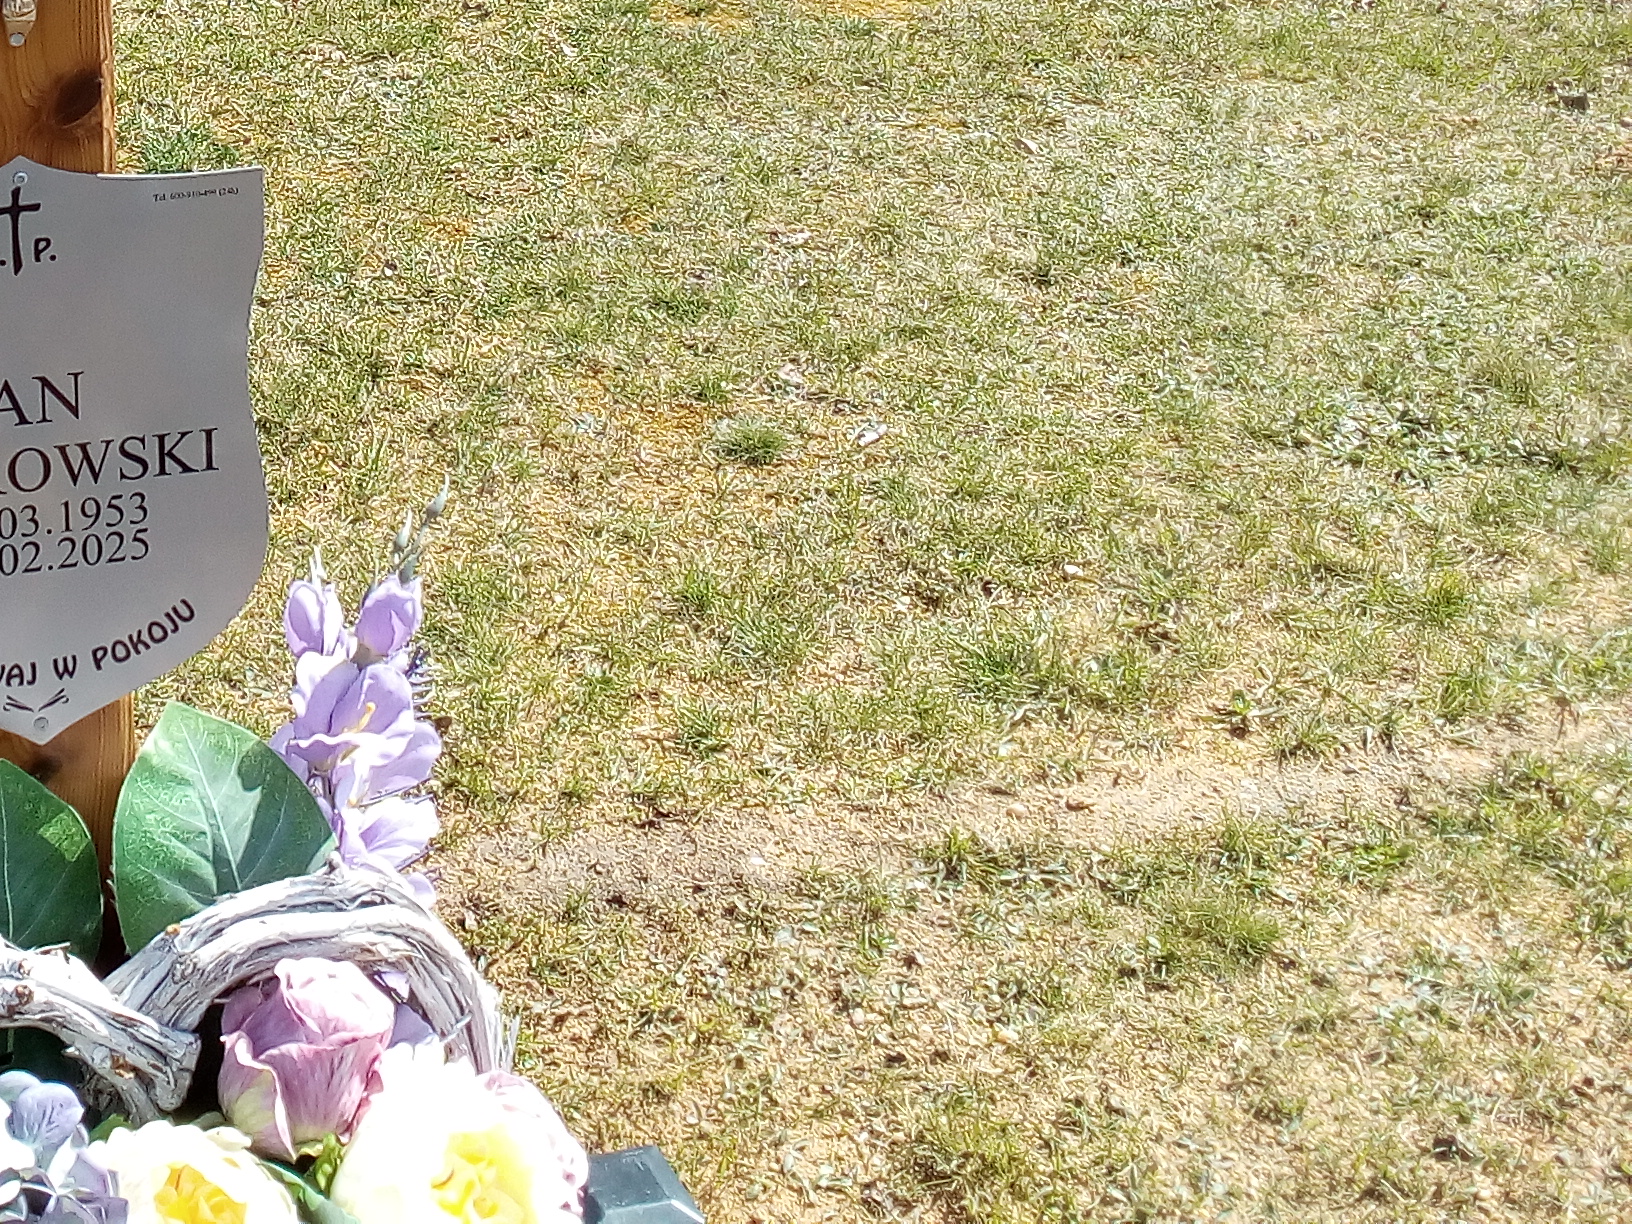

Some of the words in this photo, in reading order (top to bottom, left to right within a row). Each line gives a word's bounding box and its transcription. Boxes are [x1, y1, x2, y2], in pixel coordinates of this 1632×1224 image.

[33, 237, 57, 263] P.
[52, 653, 78, 681] W
[90, 597, 196, 672] POKOJU
